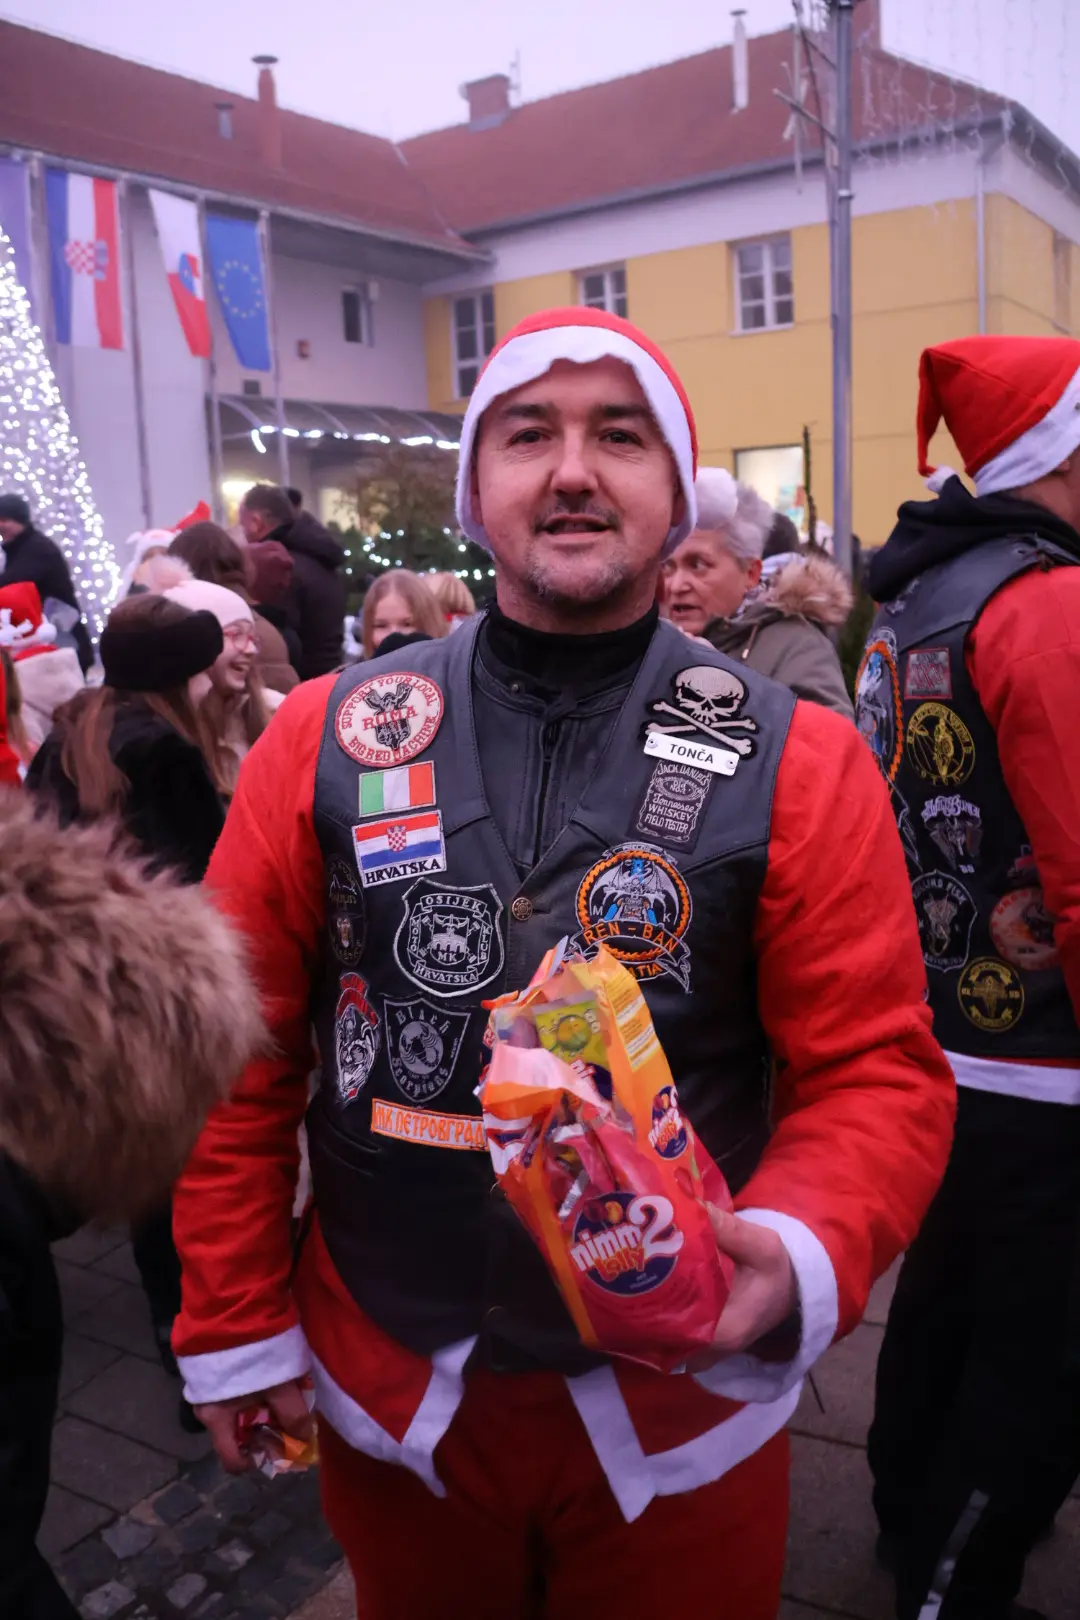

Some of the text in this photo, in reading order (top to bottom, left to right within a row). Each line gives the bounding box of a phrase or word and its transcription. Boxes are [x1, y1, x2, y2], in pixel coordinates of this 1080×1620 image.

[341, 676, 438, 730] SUPPORT YOUR LOCAL
[361, 704, 419, 731] ROMA
[348, 715, 438, 761] BIG RED MACHINE
[669, 743, 714, 765] TONČA
[657, 762, 679, 775] JACK
[648, 803, 694, 822] WHISKEY
[652, 792, 695, 813] Tennessee
[644, 813, 689, 834] FIELD TESTER
[365, 858, 441, 885] HRVATSKA
[425, 895, 482, 911] OSIJEK
[410, 918, 419, 952] MOTO
[480, 925, 491, 960] KLUB
[437, 951, 457, 962] MK
[415, 963, 478, 983] HRVATSKA
[569, 1223, 642, 1273] nimm
[627, 1195, 684, 1258] 2
